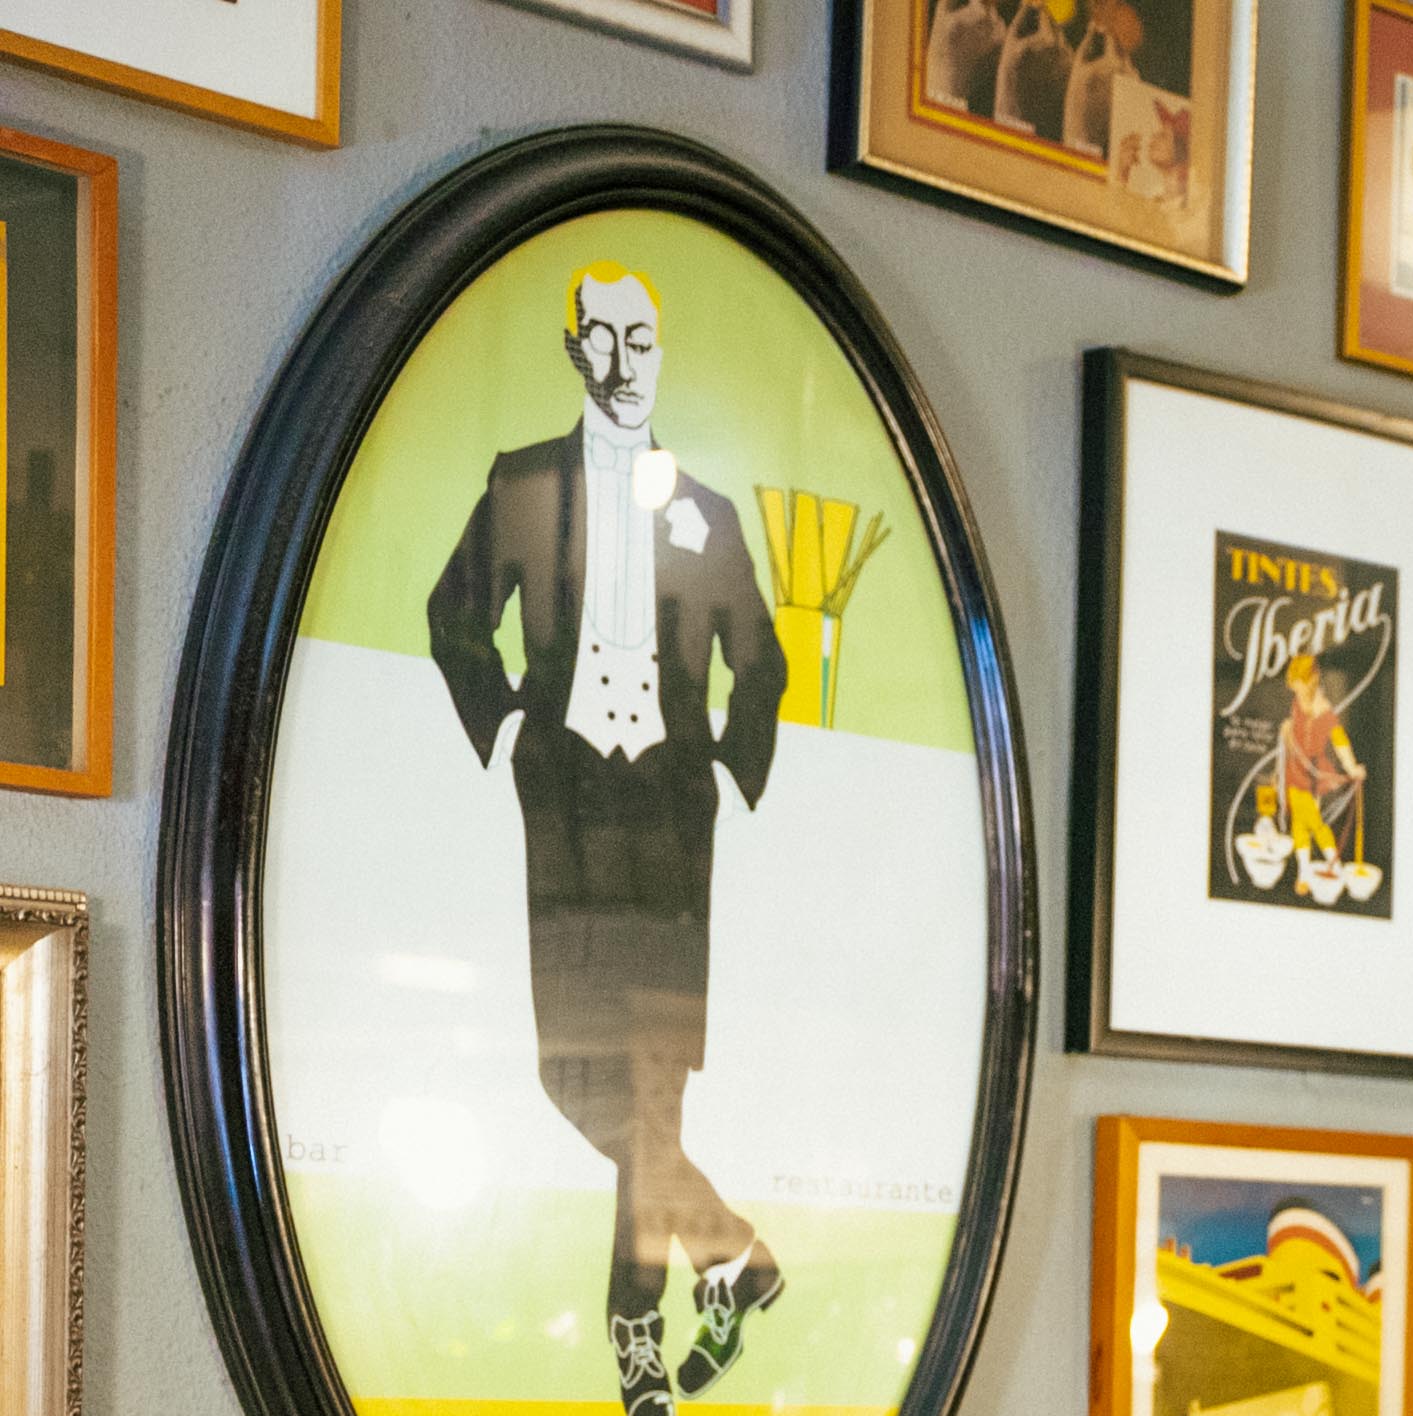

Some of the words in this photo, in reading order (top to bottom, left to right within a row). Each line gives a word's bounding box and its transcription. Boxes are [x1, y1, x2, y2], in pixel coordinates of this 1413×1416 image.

[1228, 547, 1338, 599] TINTES
[1220, 583, 1391, 717] Iberia
[286, 1134, 349, 1161] bar
